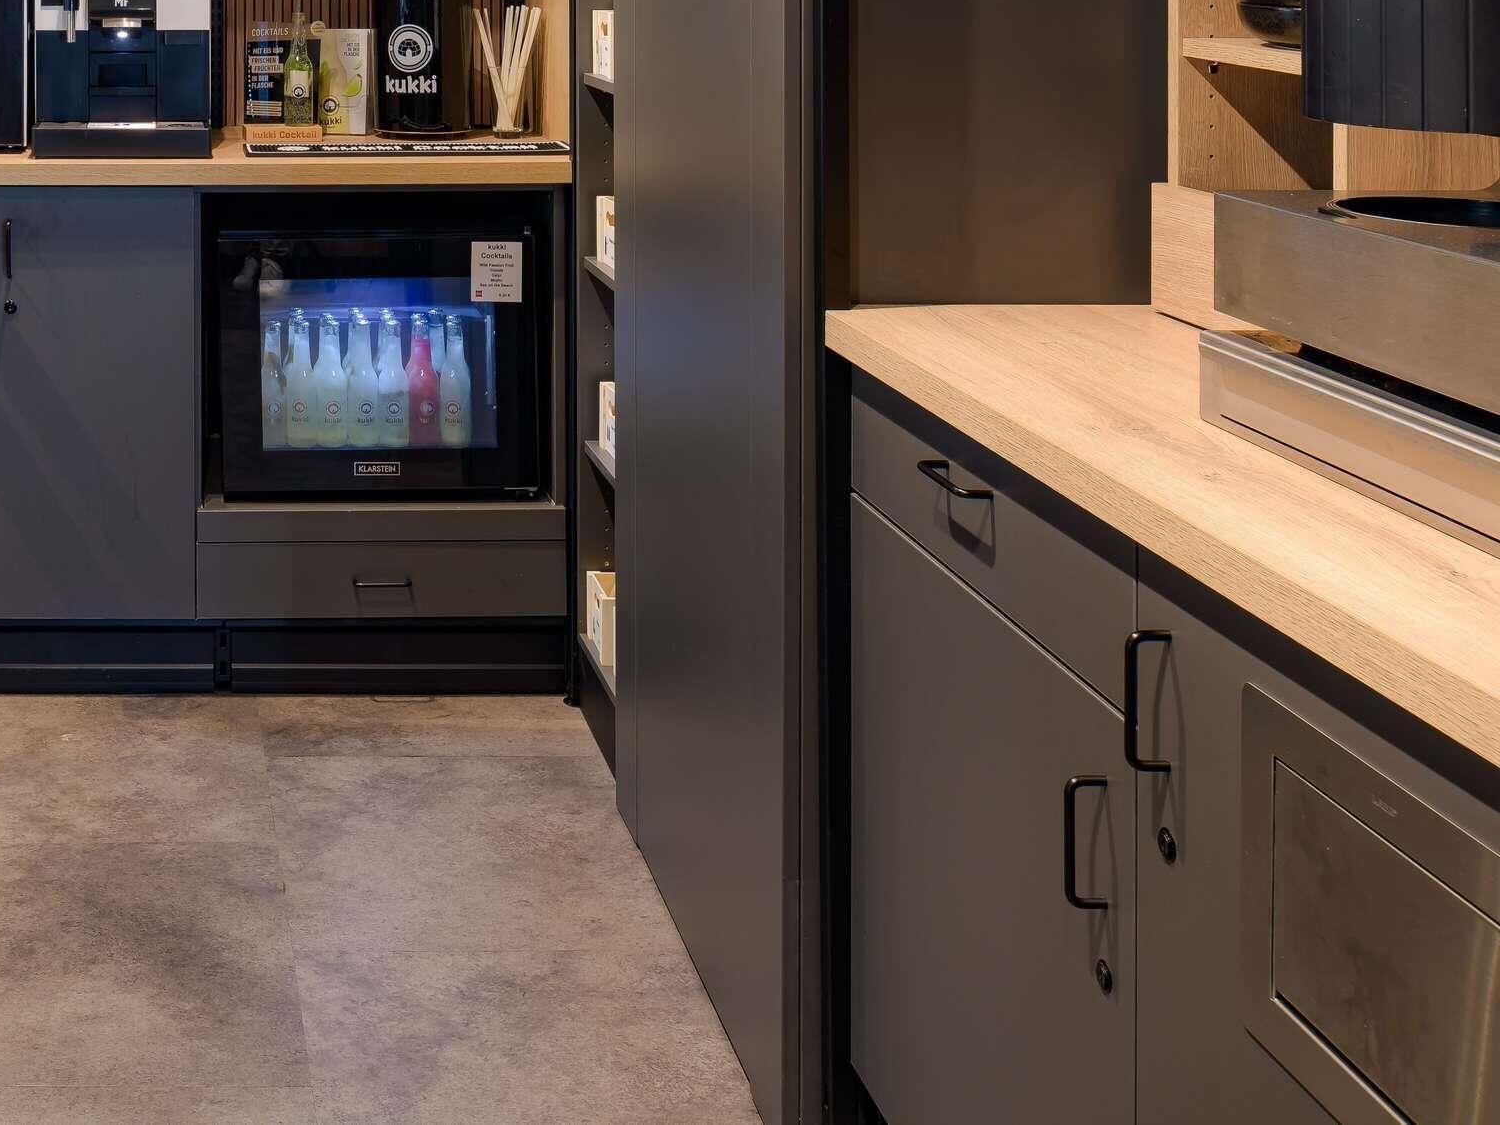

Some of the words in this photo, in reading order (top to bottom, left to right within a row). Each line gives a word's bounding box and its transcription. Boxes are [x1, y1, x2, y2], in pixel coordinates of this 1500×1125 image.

[252, 27, 289, 37] COCKTAILS
[385, 75, 437, 93] kukki
[252, 130, 276, 139] kukki
[280, 130, 316, 139] Cocktail
[358, 465, 397, 473] KLARSTEIN
